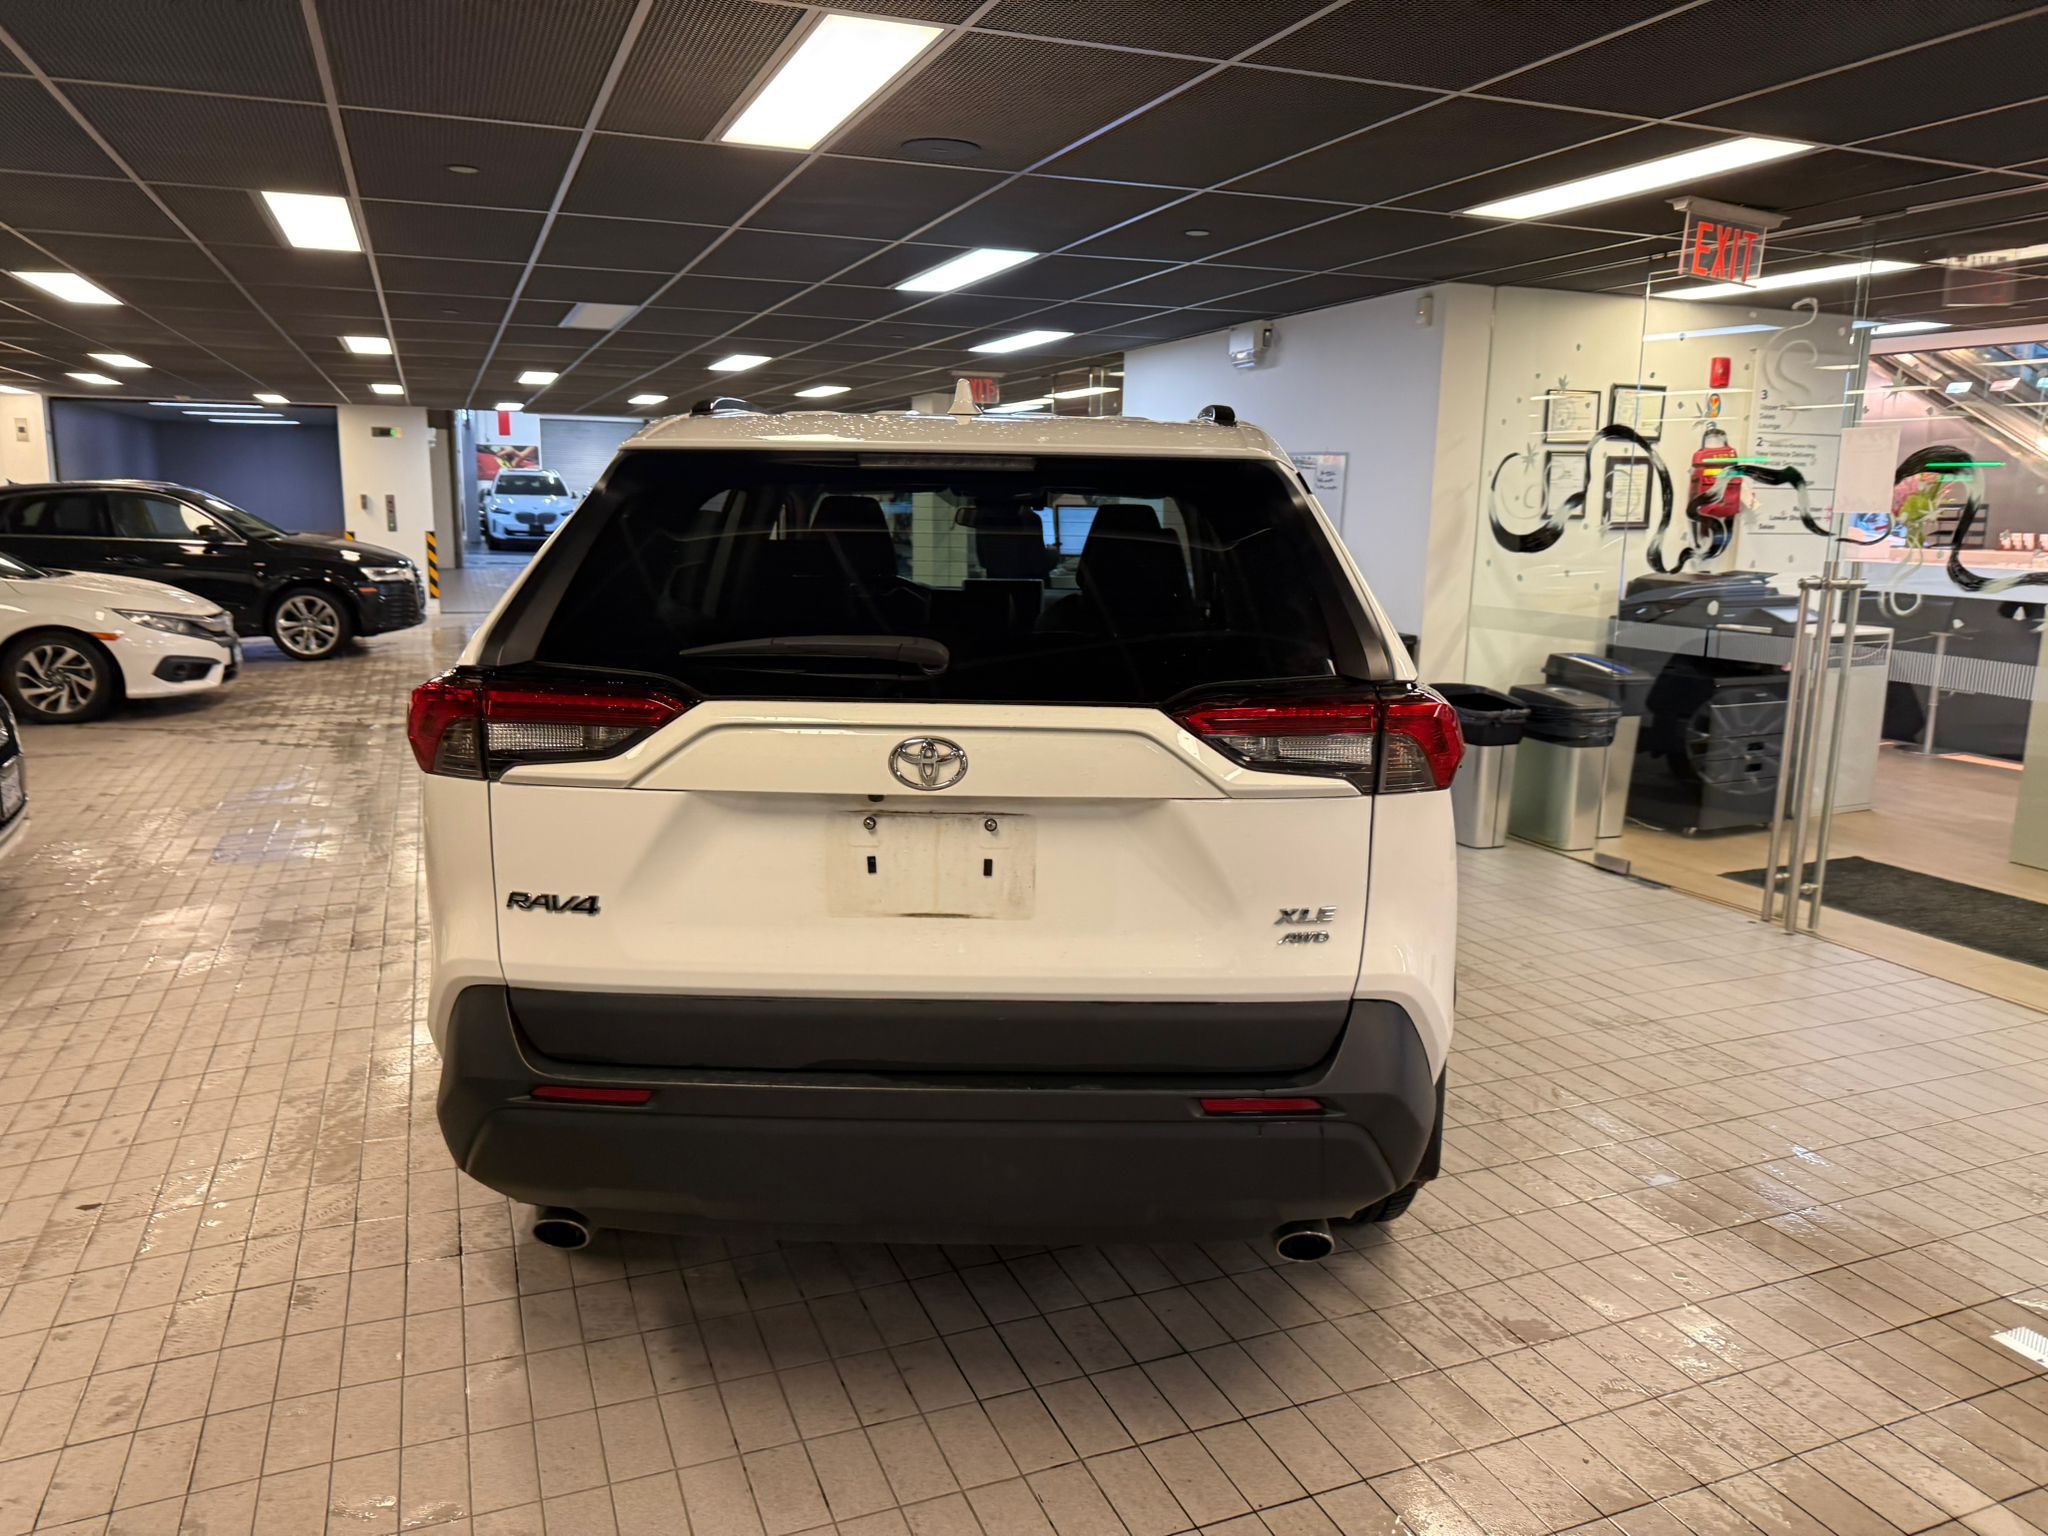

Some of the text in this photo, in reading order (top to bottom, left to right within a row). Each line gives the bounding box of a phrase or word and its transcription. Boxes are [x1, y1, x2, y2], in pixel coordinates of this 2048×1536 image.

[1692, 221, 1760, 284] EXIT
[970, 378, 993, 403] XIT
[1761, 389, 1768, 400] 3
[1756, 437, 1763, 447] 2
[506, 891, 601, 916] RAV4
[1274, 905, 1337, 925] XLE
[1277, 930, 1330, 945] AWD
